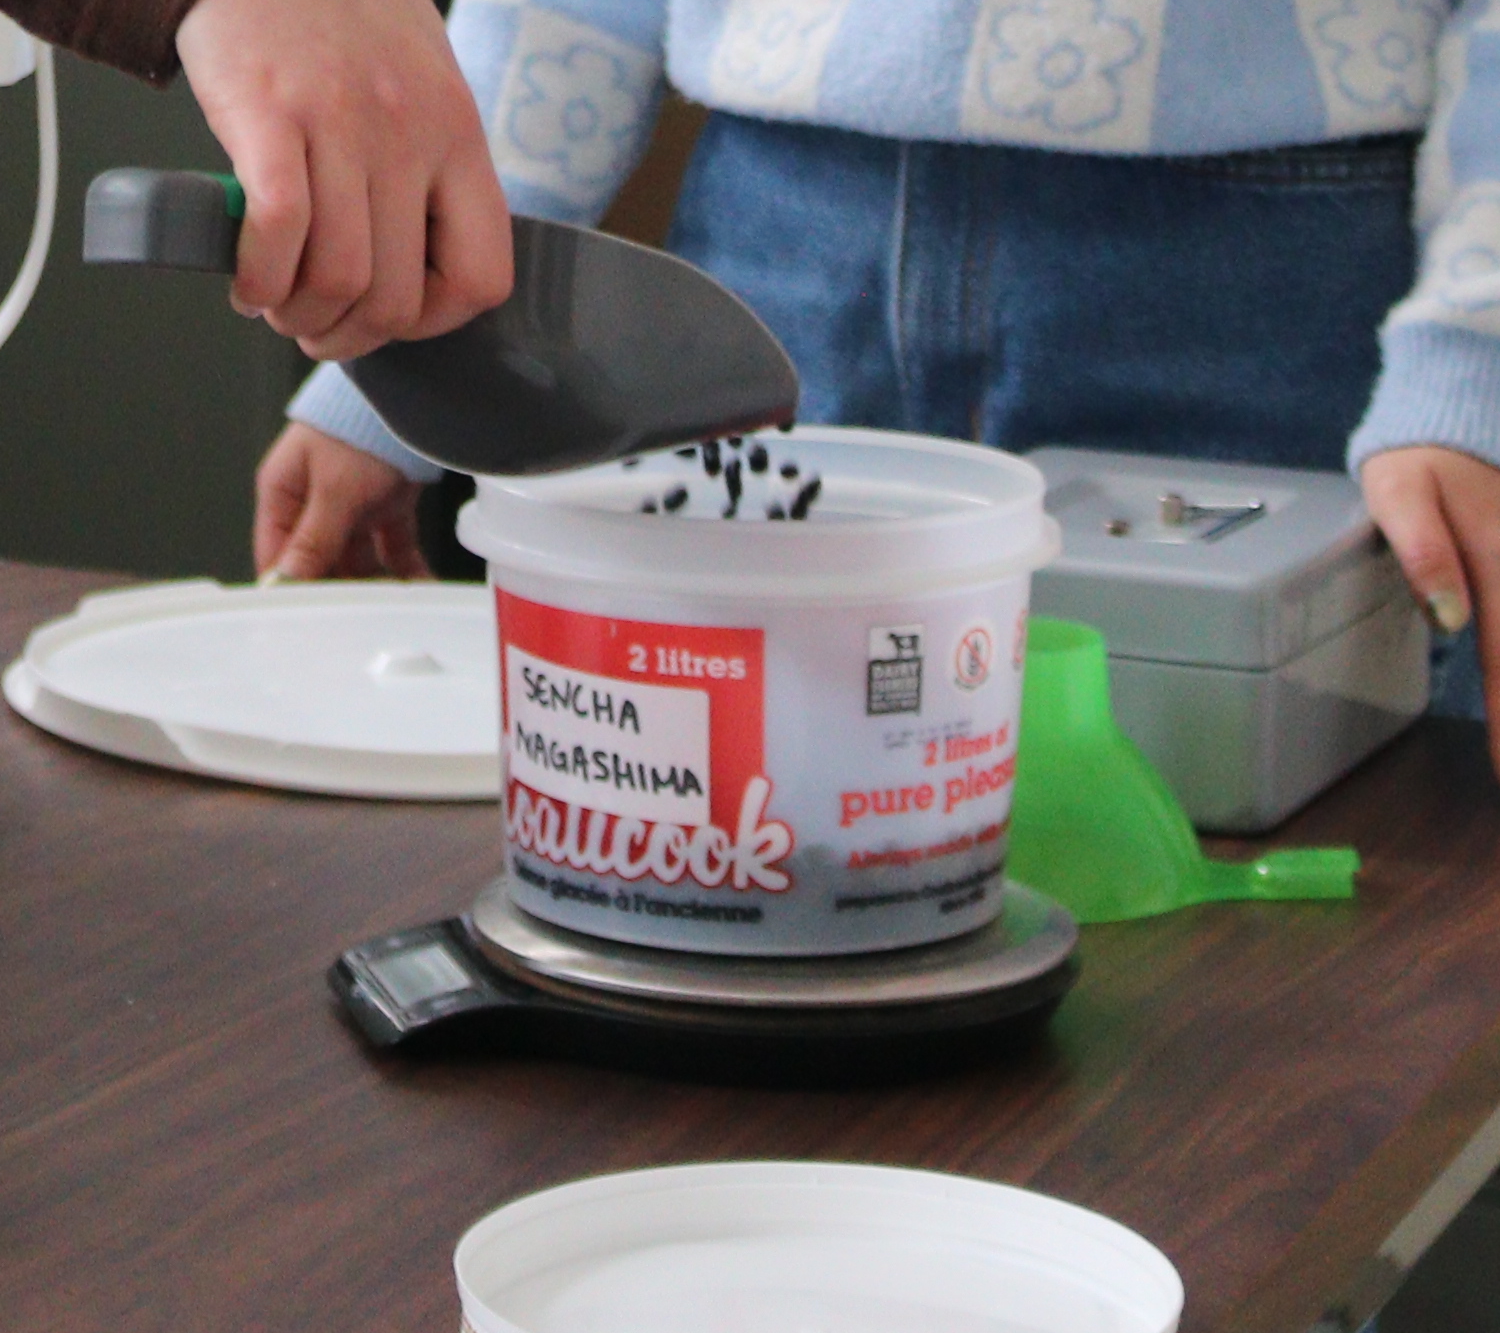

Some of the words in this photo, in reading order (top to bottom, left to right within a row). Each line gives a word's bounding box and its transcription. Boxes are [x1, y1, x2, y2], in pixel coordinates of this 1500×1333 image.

[627, 644, 648, 674] 2
[655, 646, 747, 681] litres
[522, 666, 641, 734] SENCHA
[516, 720, 704, 798] NAGASHIMA
[924, 740, 938, 767] 2
[839, 782, 934, 828] pure
